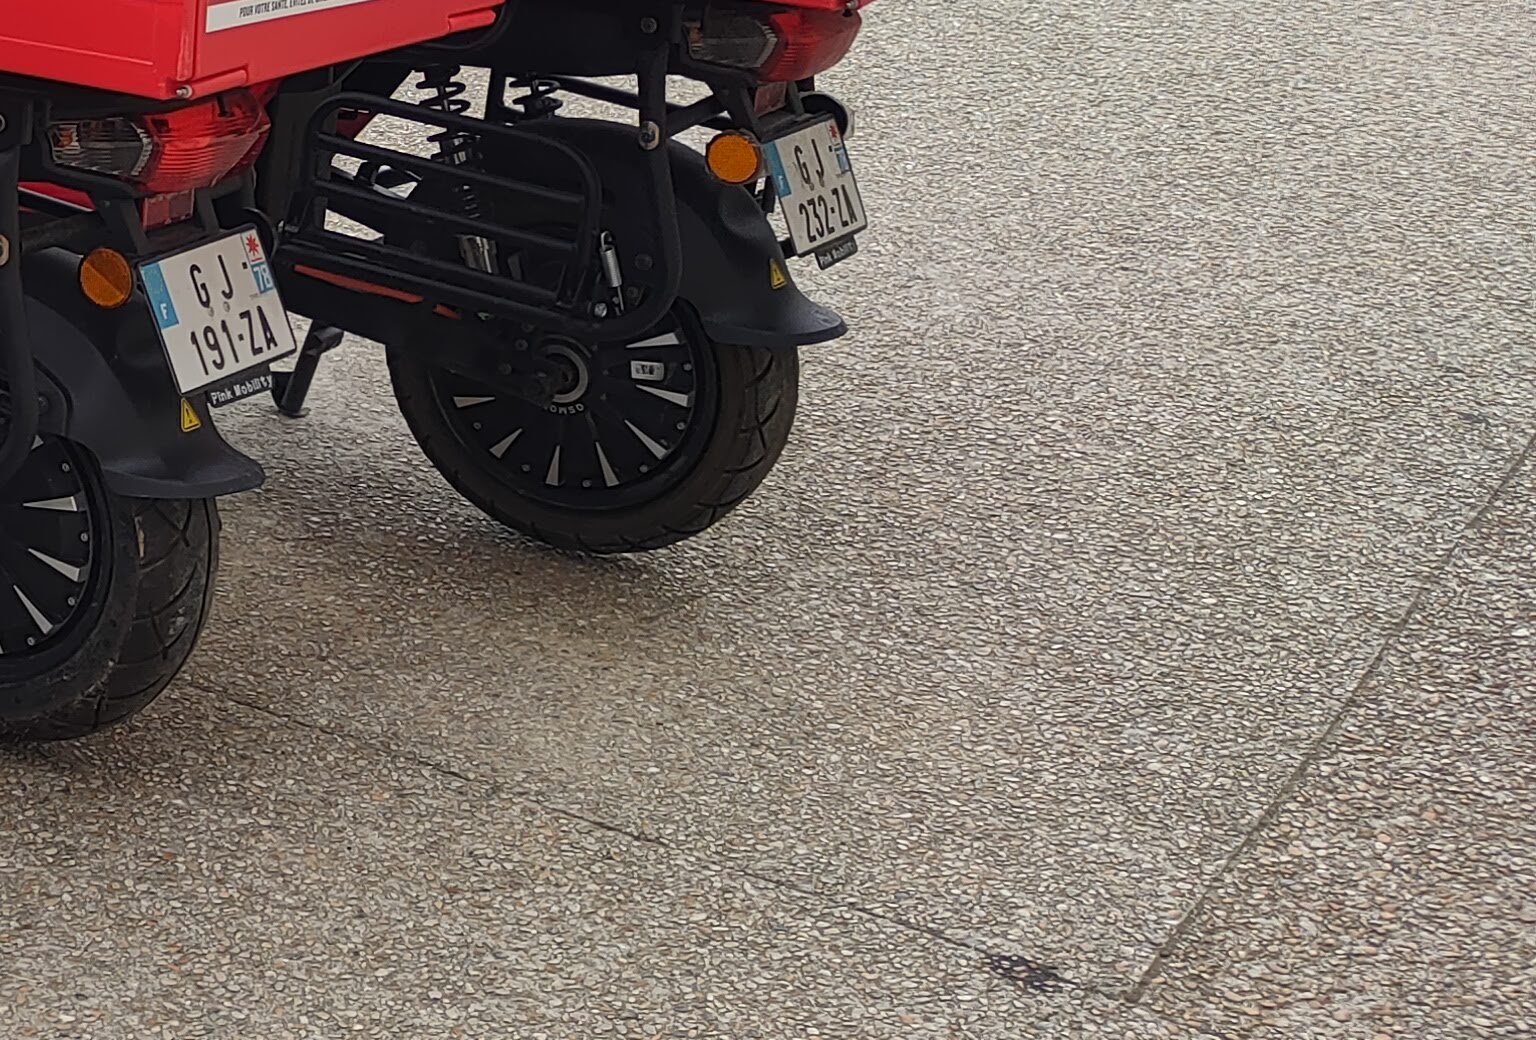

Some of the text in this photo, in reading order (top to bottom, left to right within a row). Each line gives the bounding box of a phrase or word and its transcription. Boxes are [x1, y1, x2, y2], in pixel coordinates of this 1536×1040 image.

[239, 5, 253, 18] POUR
[254, 1, 270, 14] VOTRE
[798, 184, 858, 243] 232-ZA
[253, 264, 273, 292] 78
[190, 305, 278, 376] 191-ZA
[210, 375, 273, 405] Pink Mobility
